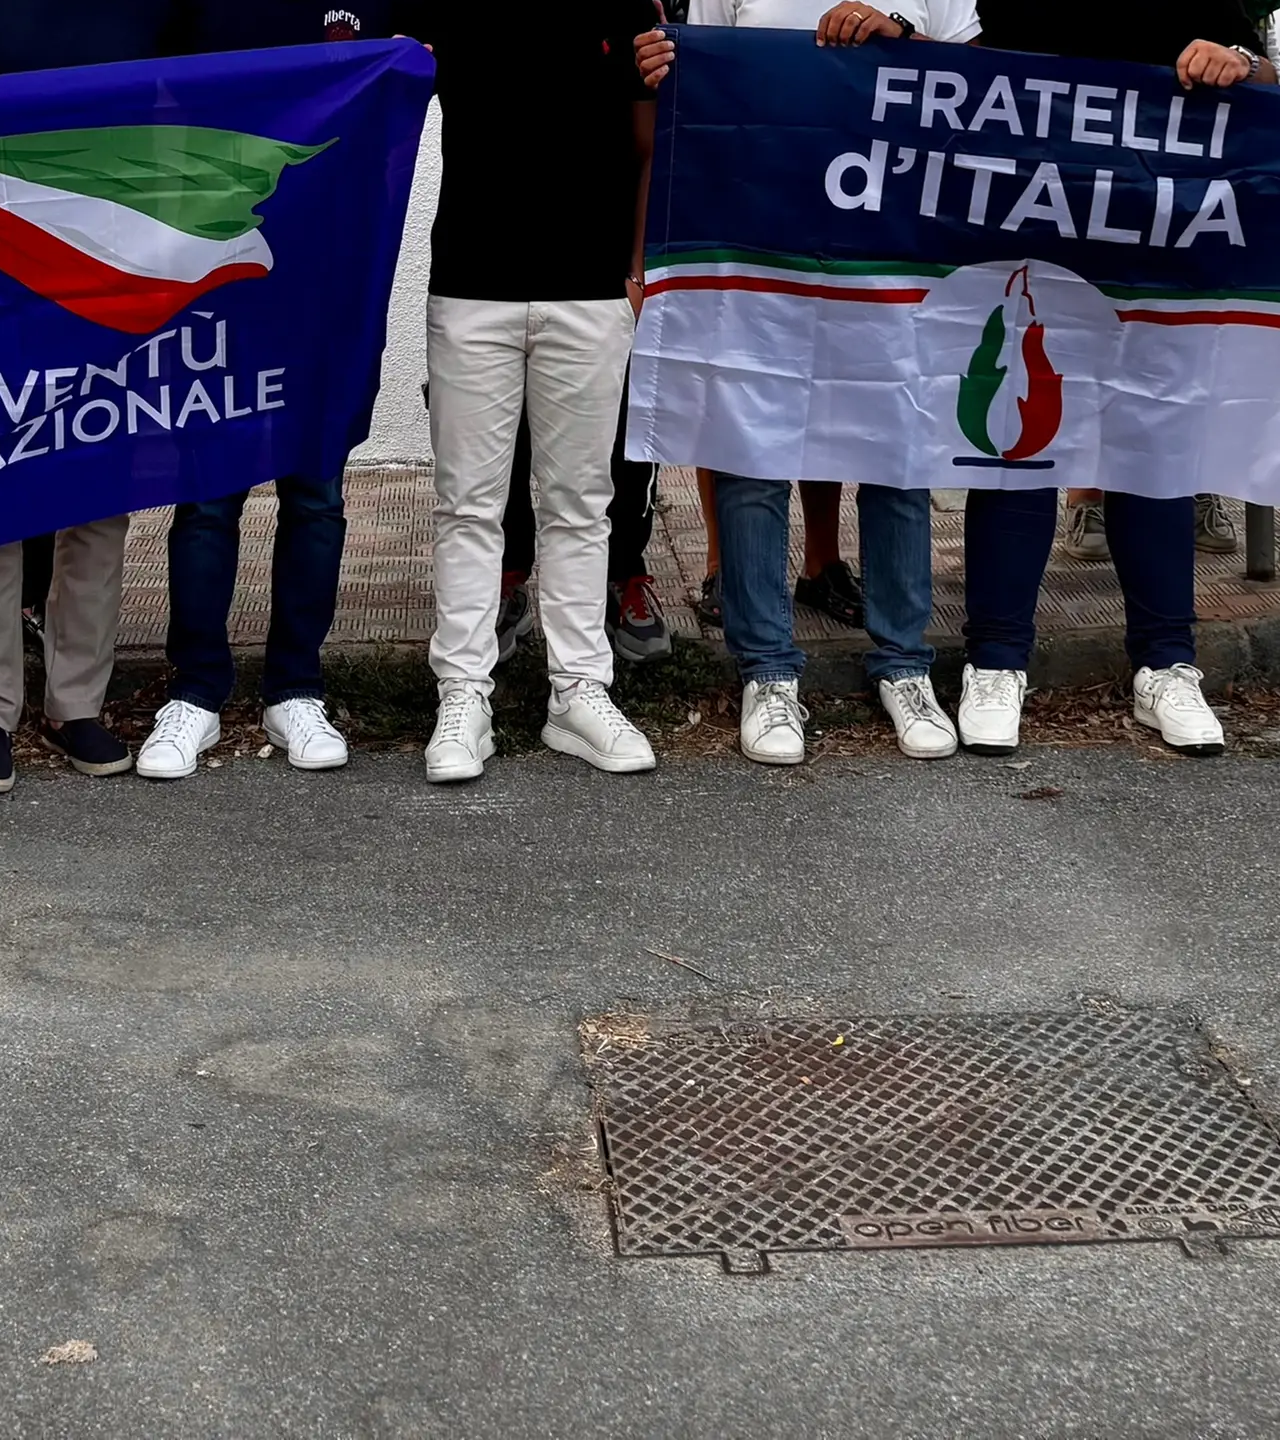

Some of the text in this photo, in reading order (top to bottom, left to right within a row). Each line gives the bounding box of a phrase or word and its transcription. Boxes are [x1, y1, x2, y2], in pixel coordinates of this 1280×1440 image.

[871, 66, 1232, 159] FRATELLI
[824, 140, 1246, 248] d'ITALIA
[853, 1214, 1084, 1241] open fiber
